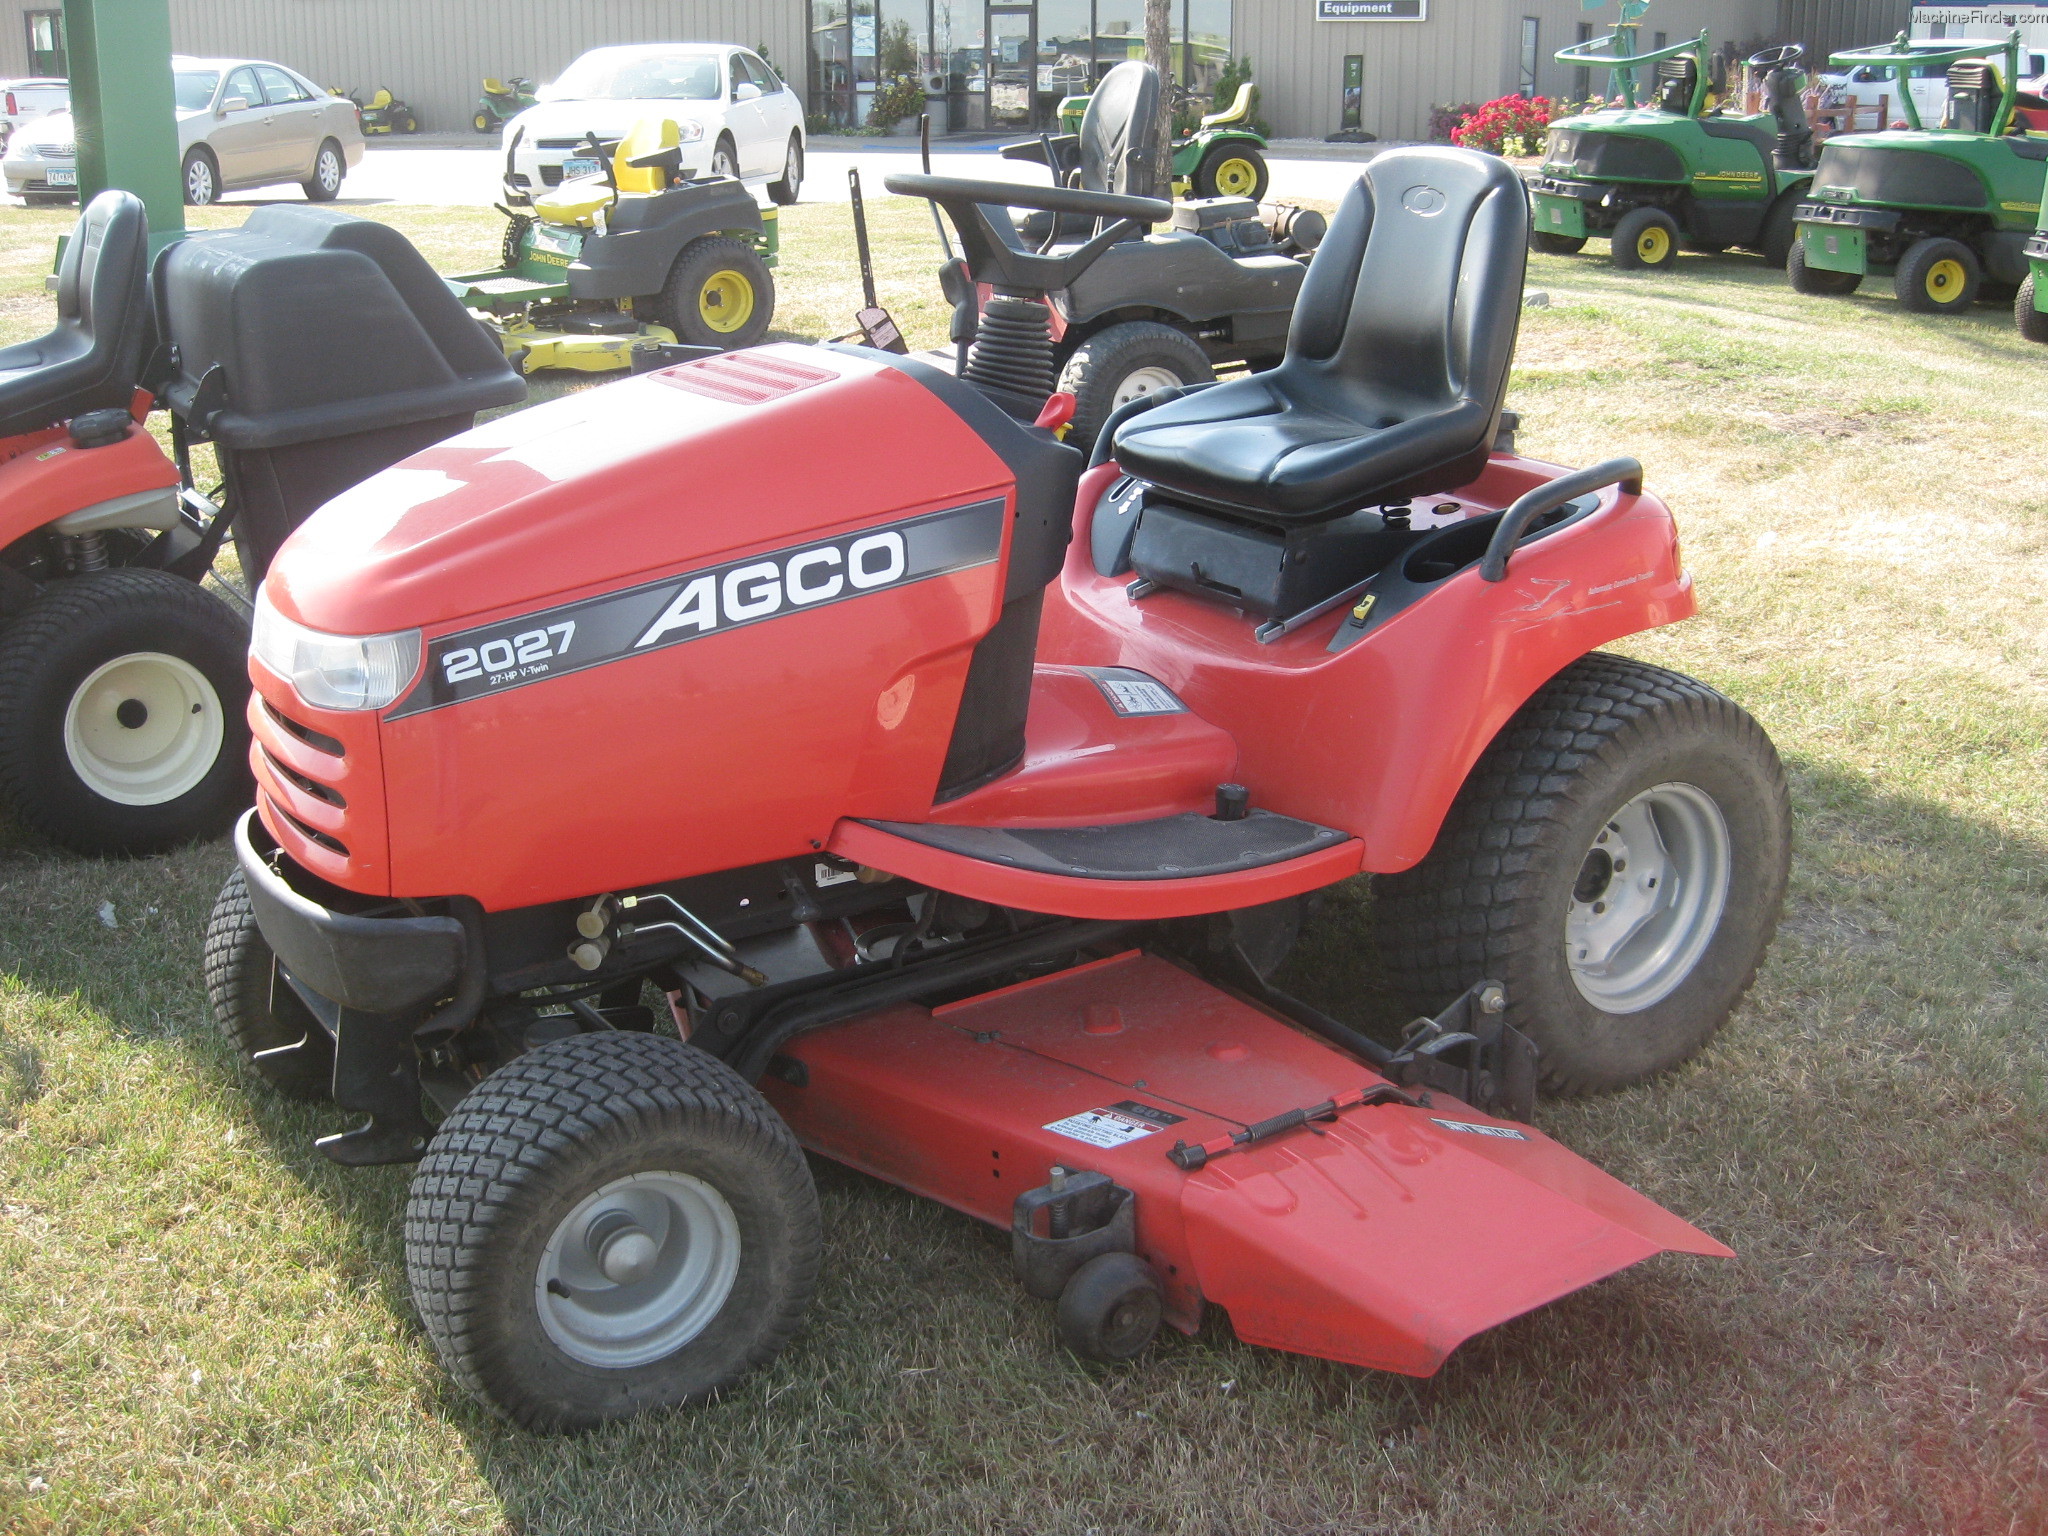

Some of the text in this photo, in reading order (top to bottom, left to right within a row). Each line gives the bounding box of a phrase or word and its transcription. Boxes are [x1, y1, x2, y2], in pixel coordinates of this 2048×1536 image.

[1324, 2, 1393, 15] Equipment
[529, 250, 569, 267] JOHN DEERE
[633, 531, 905, 649] AGCO
[442, 620, 576, 684] 2027
[490, 663, 549, 686] 27-HP V-Twin
[1113, 1114, 1147, 1128] DANGER
